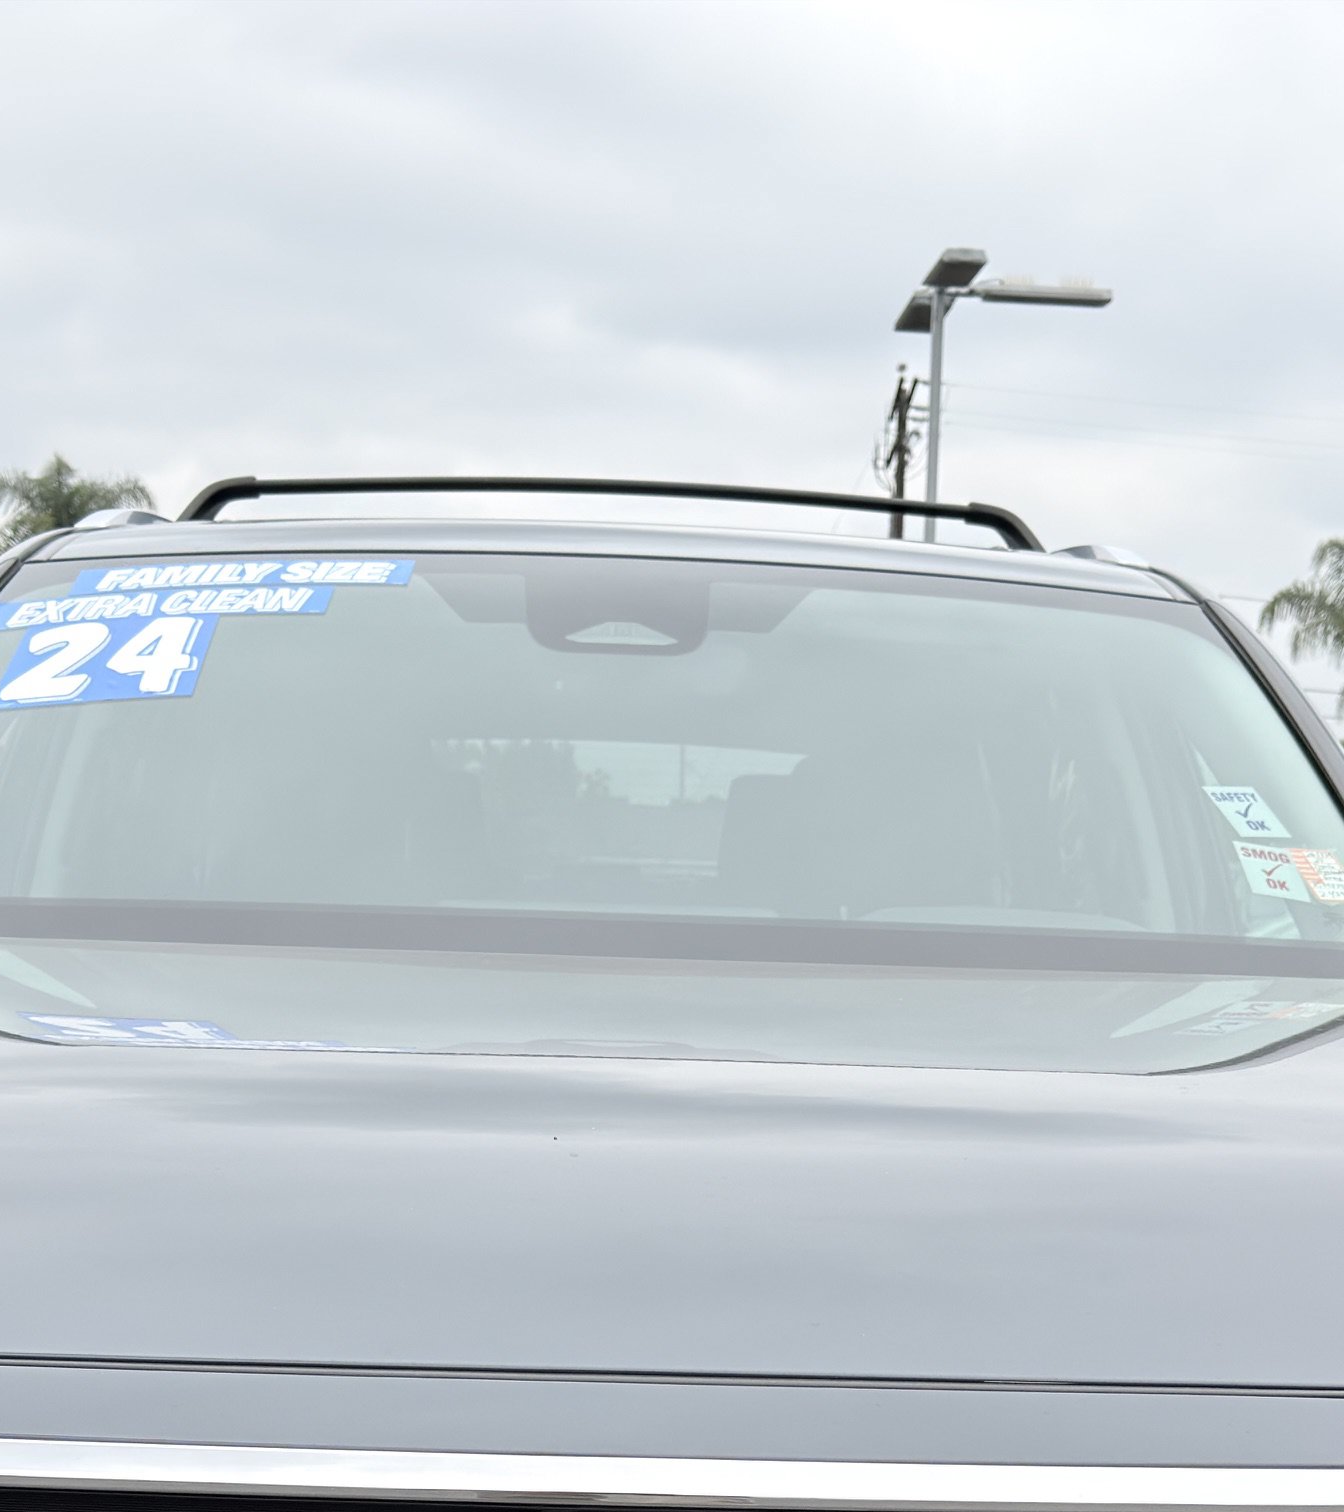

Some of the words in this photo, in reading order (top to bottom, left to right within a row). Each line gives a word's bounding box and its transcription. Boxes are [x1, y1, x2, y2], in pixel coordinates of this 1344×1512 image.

[96, 561, 278, 591] FAMILY
[280, 560, 397, 584] SIZE
[6, 590, 157, 628] EXTRA
[159, 587, 315, 615] CLEAN
[0, 617, 203, 704] 24
[1210, 791, 1258, 804] SAFETY
[1246, 820, 1271, 832] OK
[1240, 846, 1291, 864] SMOG
[1266, 877, 1290, 892] OK
